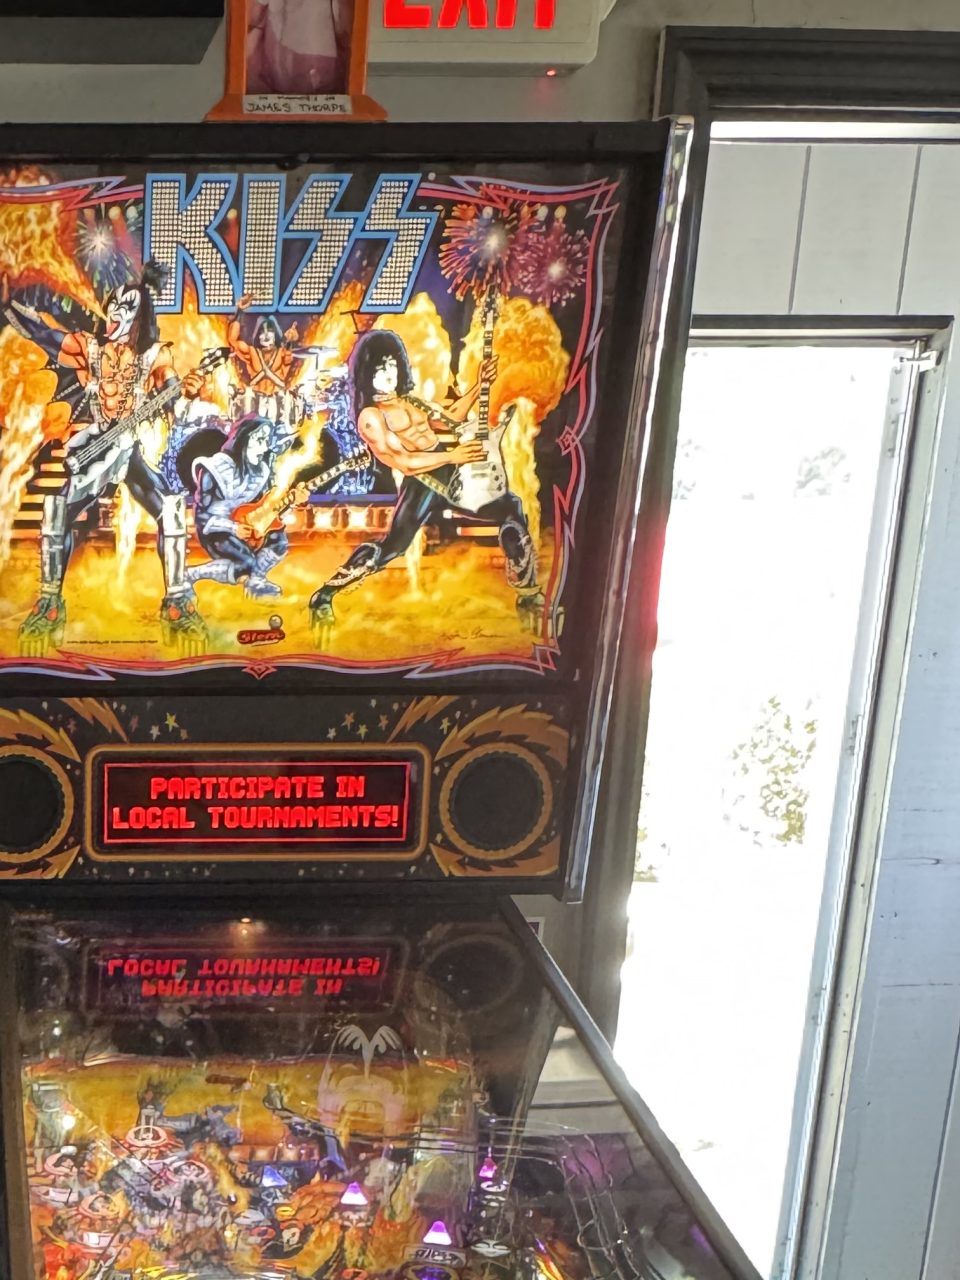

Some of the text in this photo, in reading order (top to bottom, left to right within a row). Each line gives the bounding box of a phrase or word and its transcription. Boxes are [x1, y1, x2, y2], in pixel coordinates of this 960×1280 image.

[247, 103, 291, 113] JAMES
[145, 173, 439, 315] KISS
[150, 775, 365, 800] PARTICIPATE IN
[112, 804, 400, 829] LOCAL TOURNAMENTS!
